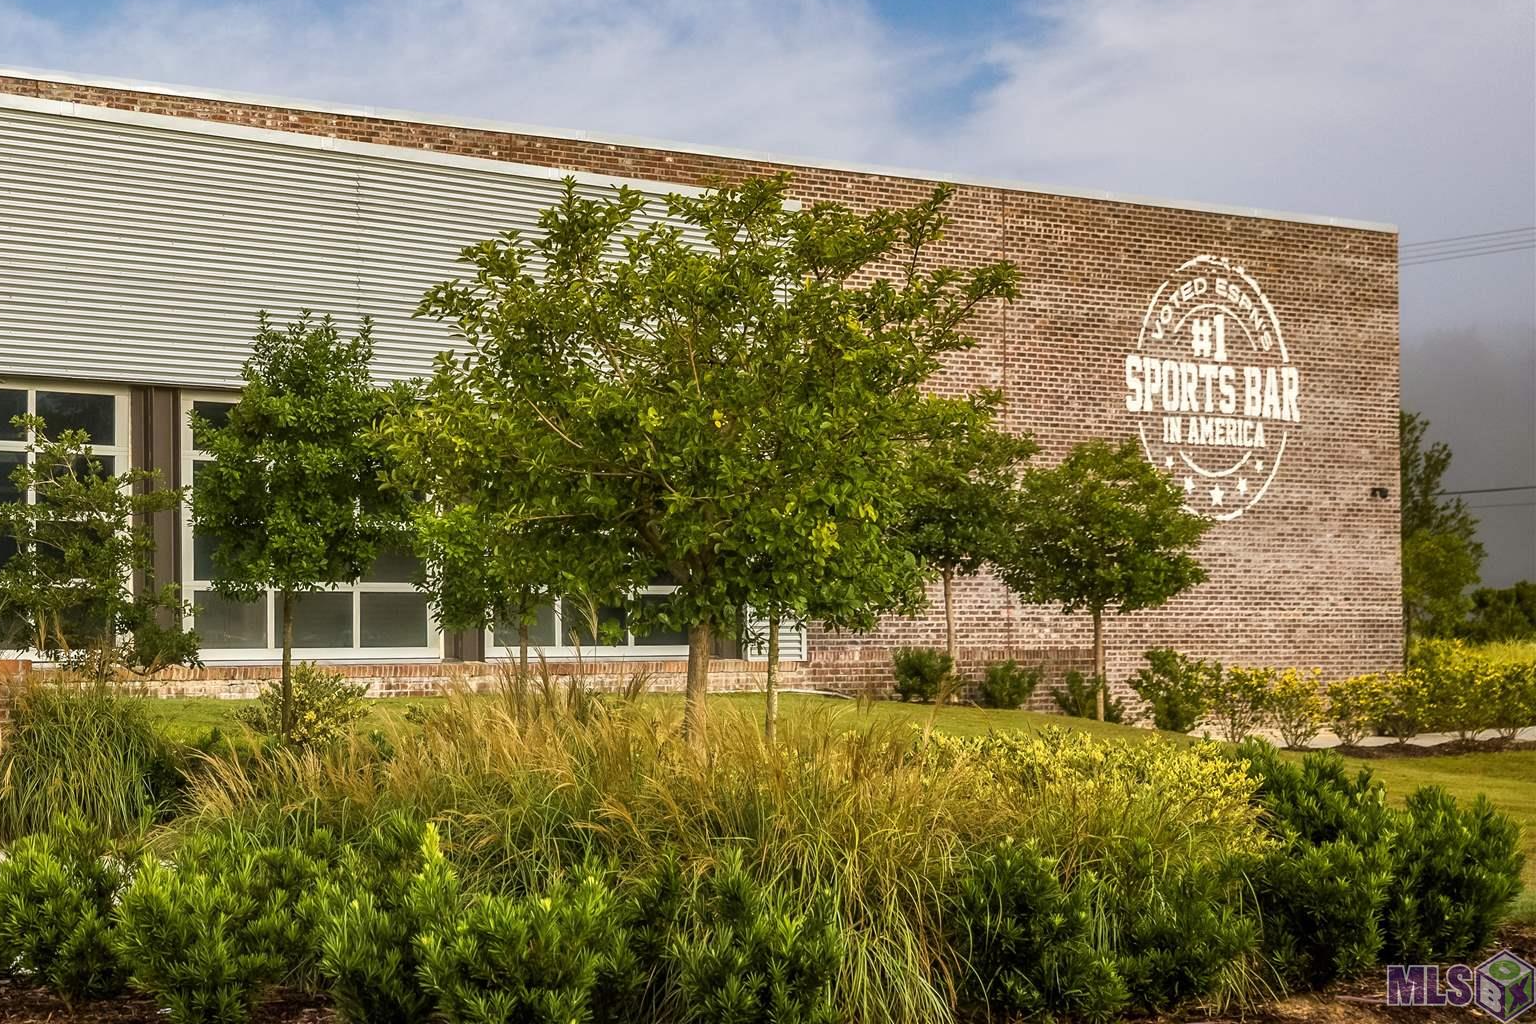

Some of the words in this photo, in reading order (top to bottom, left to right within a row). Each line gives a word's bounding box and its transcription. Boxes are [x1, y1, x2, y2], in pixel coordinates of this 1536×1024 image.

[1151, 277, 1208, 339] VOTED
[1191, 314, 1227, 362] #1
[1125, 355, 1236, 414] SPORTS
[1244, 366, 1301, 423] BAR
[1163, 416, 1182, 443] IN
[1187, 416, 1265, 448] AMERICA
